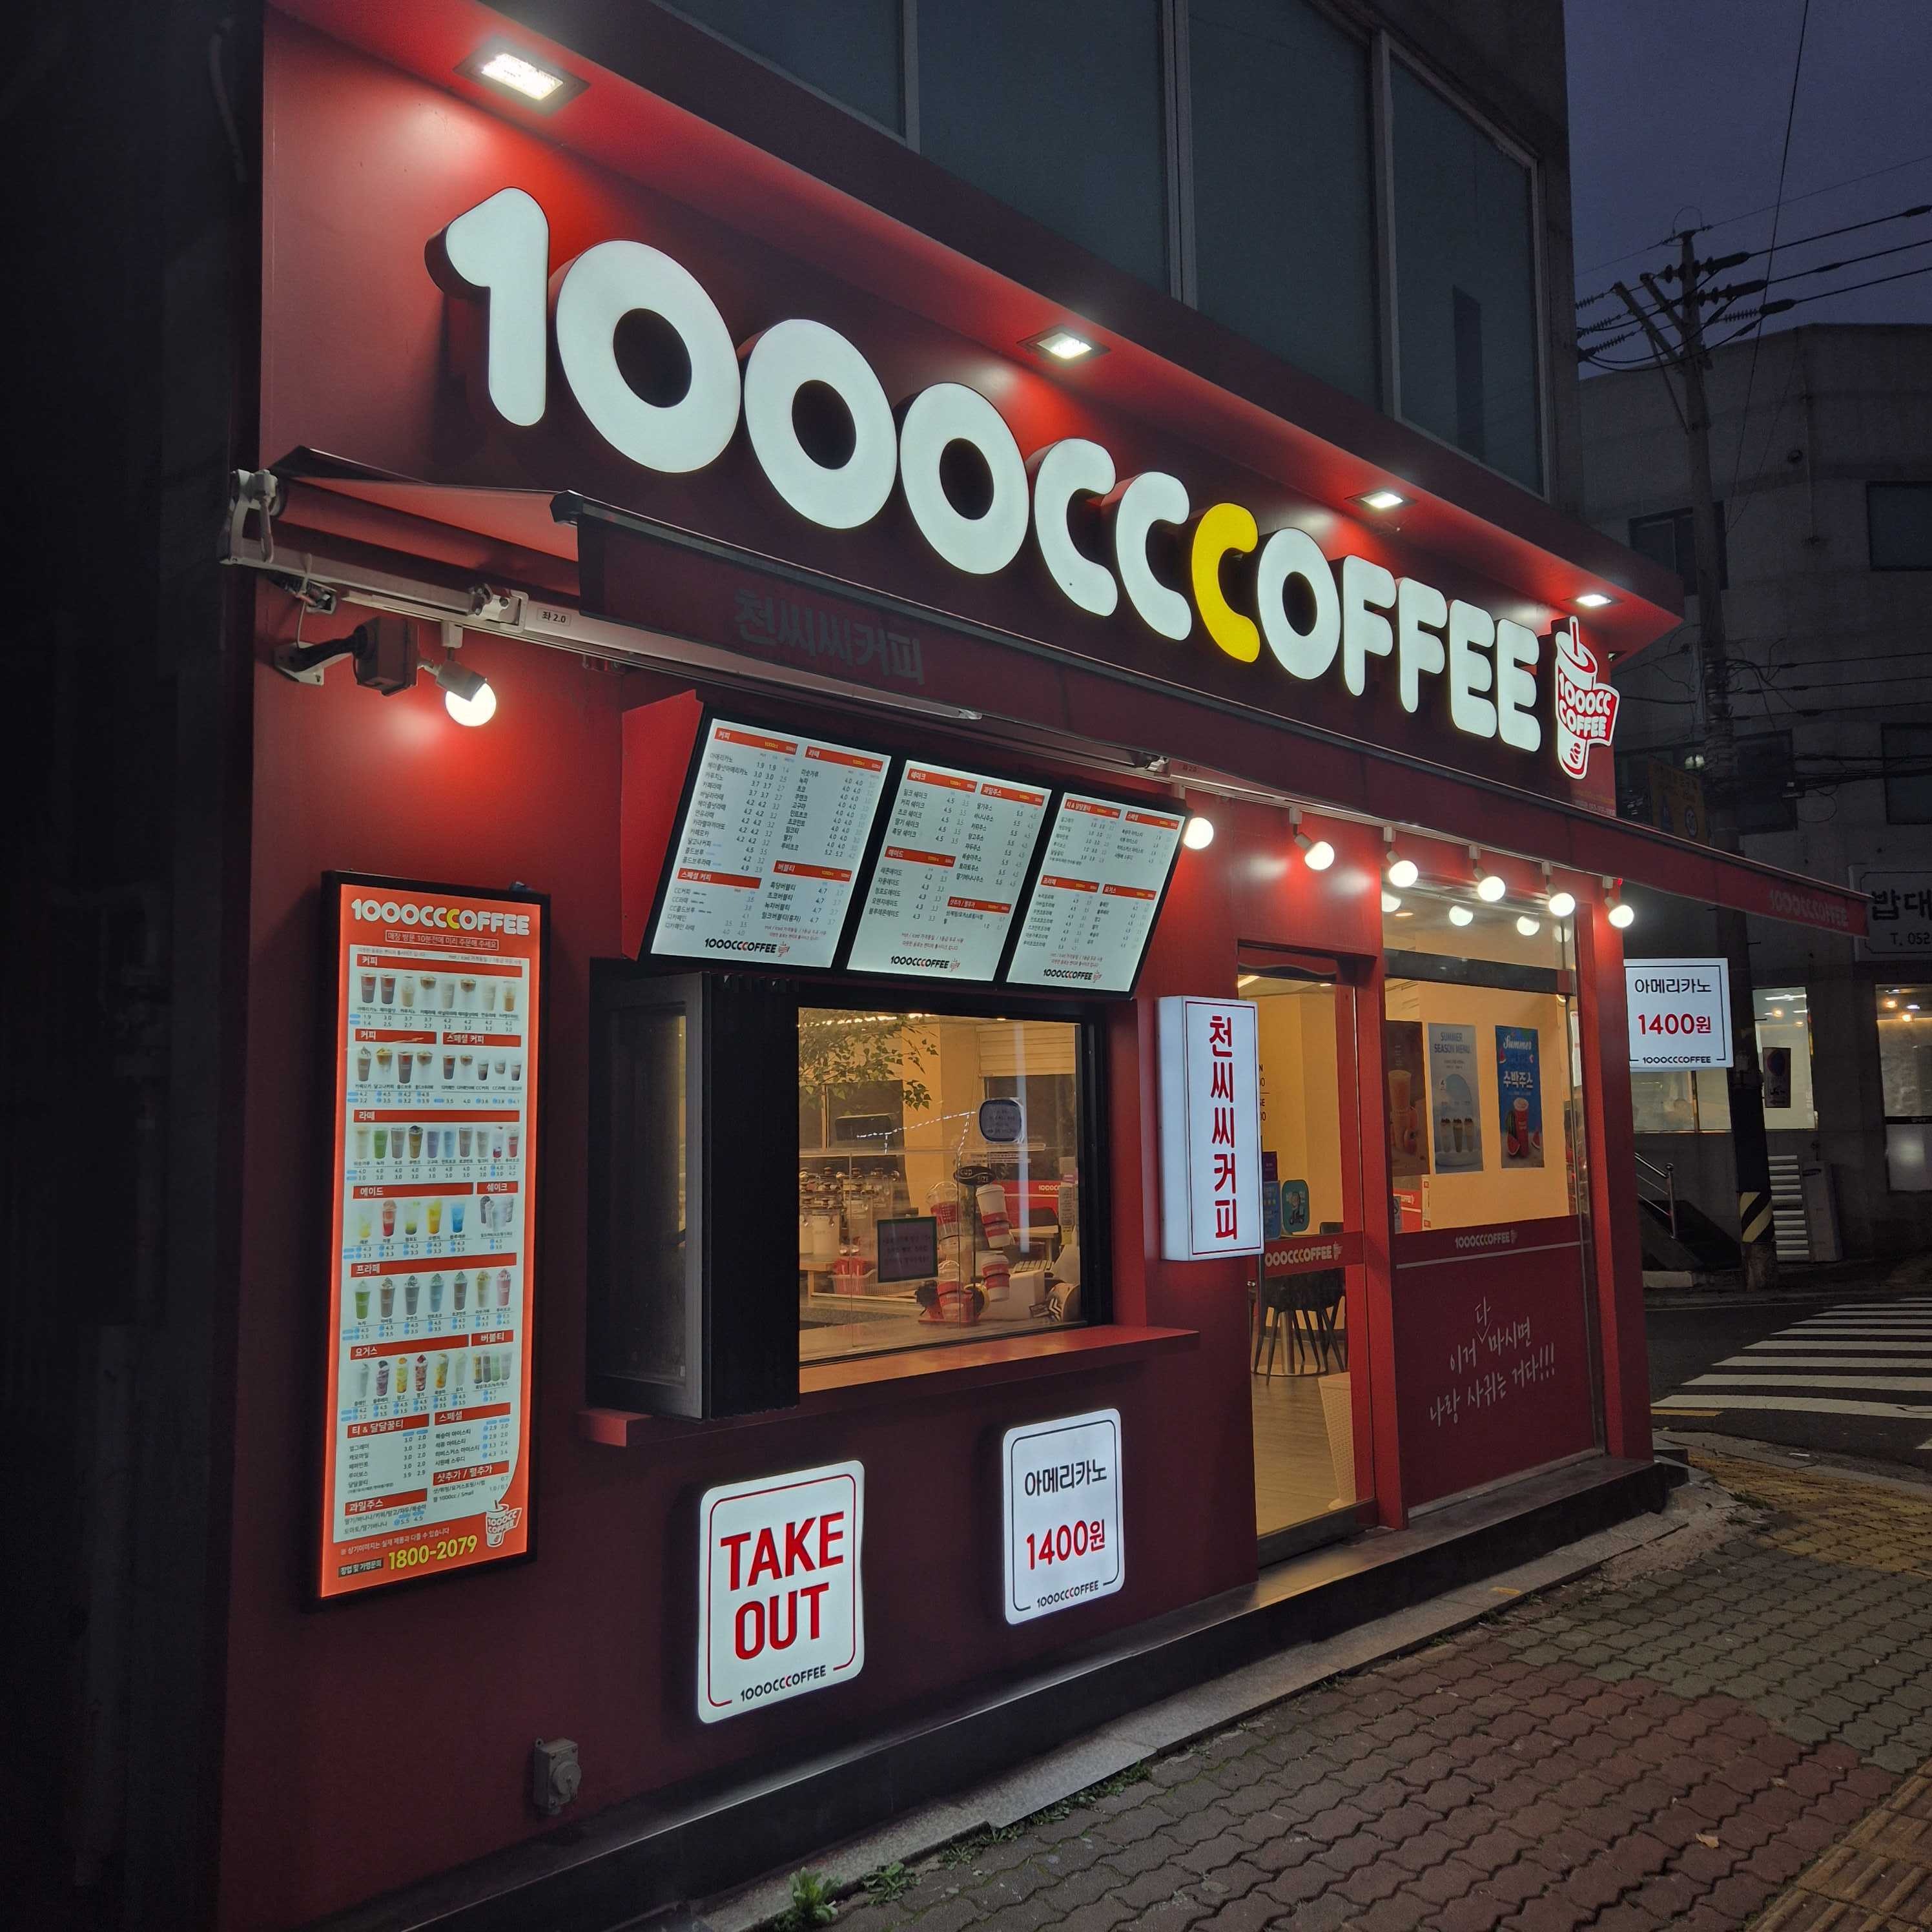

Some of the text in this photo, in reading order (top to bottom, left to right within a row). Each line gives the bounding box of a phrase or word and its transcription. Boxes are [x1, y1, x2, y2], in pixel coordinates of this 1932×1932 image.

[443, 186, 1543, 753] 1000CCCOFFEE
[552, 613, 566, 623] 2.0
[1559, 672, 1612, 717] 1000CC
[1559, 699, 1607, 738] COFFEE
[717, 731, 730, 739] 커피
[709, 752, 734, 763] 아메리카노
[776, 863, 795, 872] 버블티
[698, 872, 712, 881] 커피
[351, 898, 529, 936] 1000CCCOFFEE
[387, 931, 400, 941] 매장
[703, 938, 777, 953] 1000CCCOFFEE
[362, 955, 377, 966] 커피
[890, 955, 949, 969] 1000CCCOFFEE
[1042, 969, 1093, 980] 1000CCCOFFEE
[1634, 978, 1712, 994] 아메리카노
[1638, 1013, 1711, 1035] 1400원
[360, 1030, 376, 1040] 커피
[446, 1033, 484, 1044] 스페셜 커피
[1434, 1043, 1453, 1053] SEASON
[1642, 1056, 1711, 1064] 1000CCCOFFEE
[1503, 1070, 1534, 1089] 수박주스
[358, 1111, 375, 1120] 라떼
[1209, 1014, 1238, 1240] 천씨씨커피
[360, 1186, 384, 1197] 에이드
[1455, 1233, 1510, 1250] 1000CCCOFFEE
[1264, 1245, 1333, 1267] 000CCCOFFEE
[356, 1263, 380, 1275] 프라페
[480, 1331, 504, 1343] 버블티
[1450, 1337, 1477, 1375] 이거
[1488, 1316, 1532, 1356] 마시면
[1430, 1388, 1461, 1427] 나랑
[1467, 1372, 1507, 1408] 사귀는
[440, 1410, 462, 1423] 스페셜
[351, 1425, 360, 1436] 티
[437, 1470, 460, 1483] 샷추가
[1023, 1459, 1107, 1497] 아메리카노
[349, 1497, 383, 1513] 과일주스
[488, 1510, 517, 1525] 1000CC
[719, 1510, 845, 1592] TAKE
[1026, 1518, 1105, 1571] 1400원
[387, 1534, 478, 1571] 1800-2079
[1036, 1580, 1100, 1608] 1000CCCOFFEE
[734, 1582, 830, 1660] OUT
[740, 1664, 827, 1703] 1000CCCOFFEE
